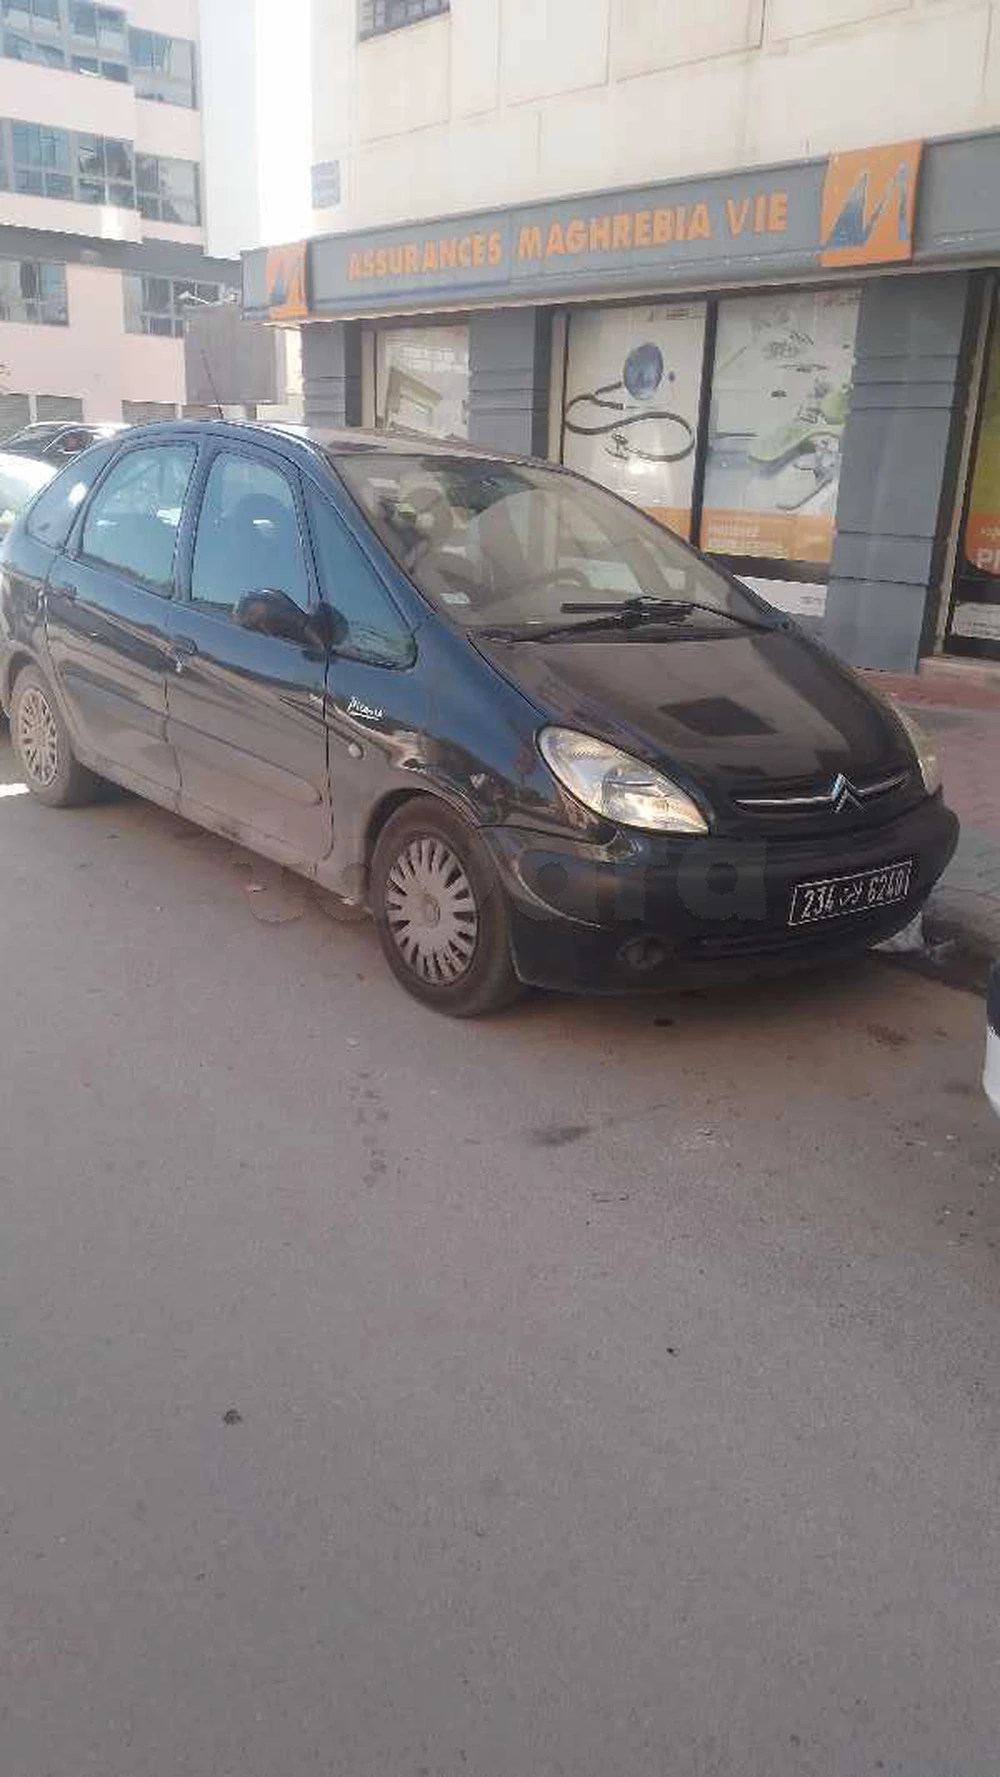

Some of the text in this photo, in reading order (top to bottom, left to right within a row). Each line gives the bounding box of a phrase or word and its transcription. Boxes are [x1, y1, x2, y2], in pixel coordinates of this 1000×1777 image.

[348, 188, 789, 281] ASSURANCES MAGHREBIA VIE
[800, 883, 836, 918] 234
